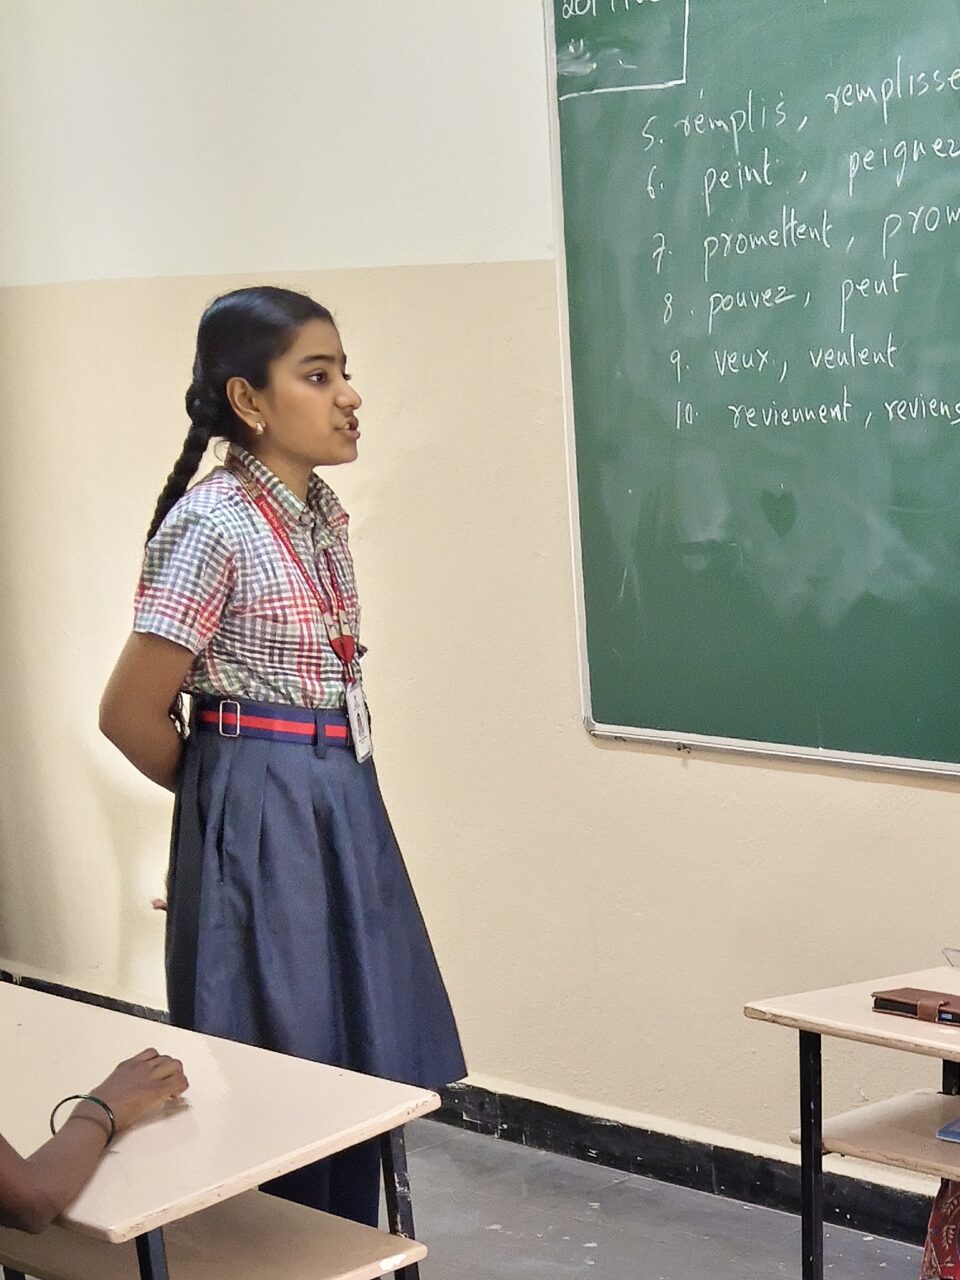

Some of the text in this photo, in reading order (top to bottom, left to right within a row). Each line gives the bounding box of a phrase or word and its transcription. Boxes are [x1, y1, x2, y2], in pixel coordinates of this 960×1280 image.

[641, 115, 664, 152] 5.
[840, 258, 909, 334] peut
[809, 331, 898, 370] veulent
